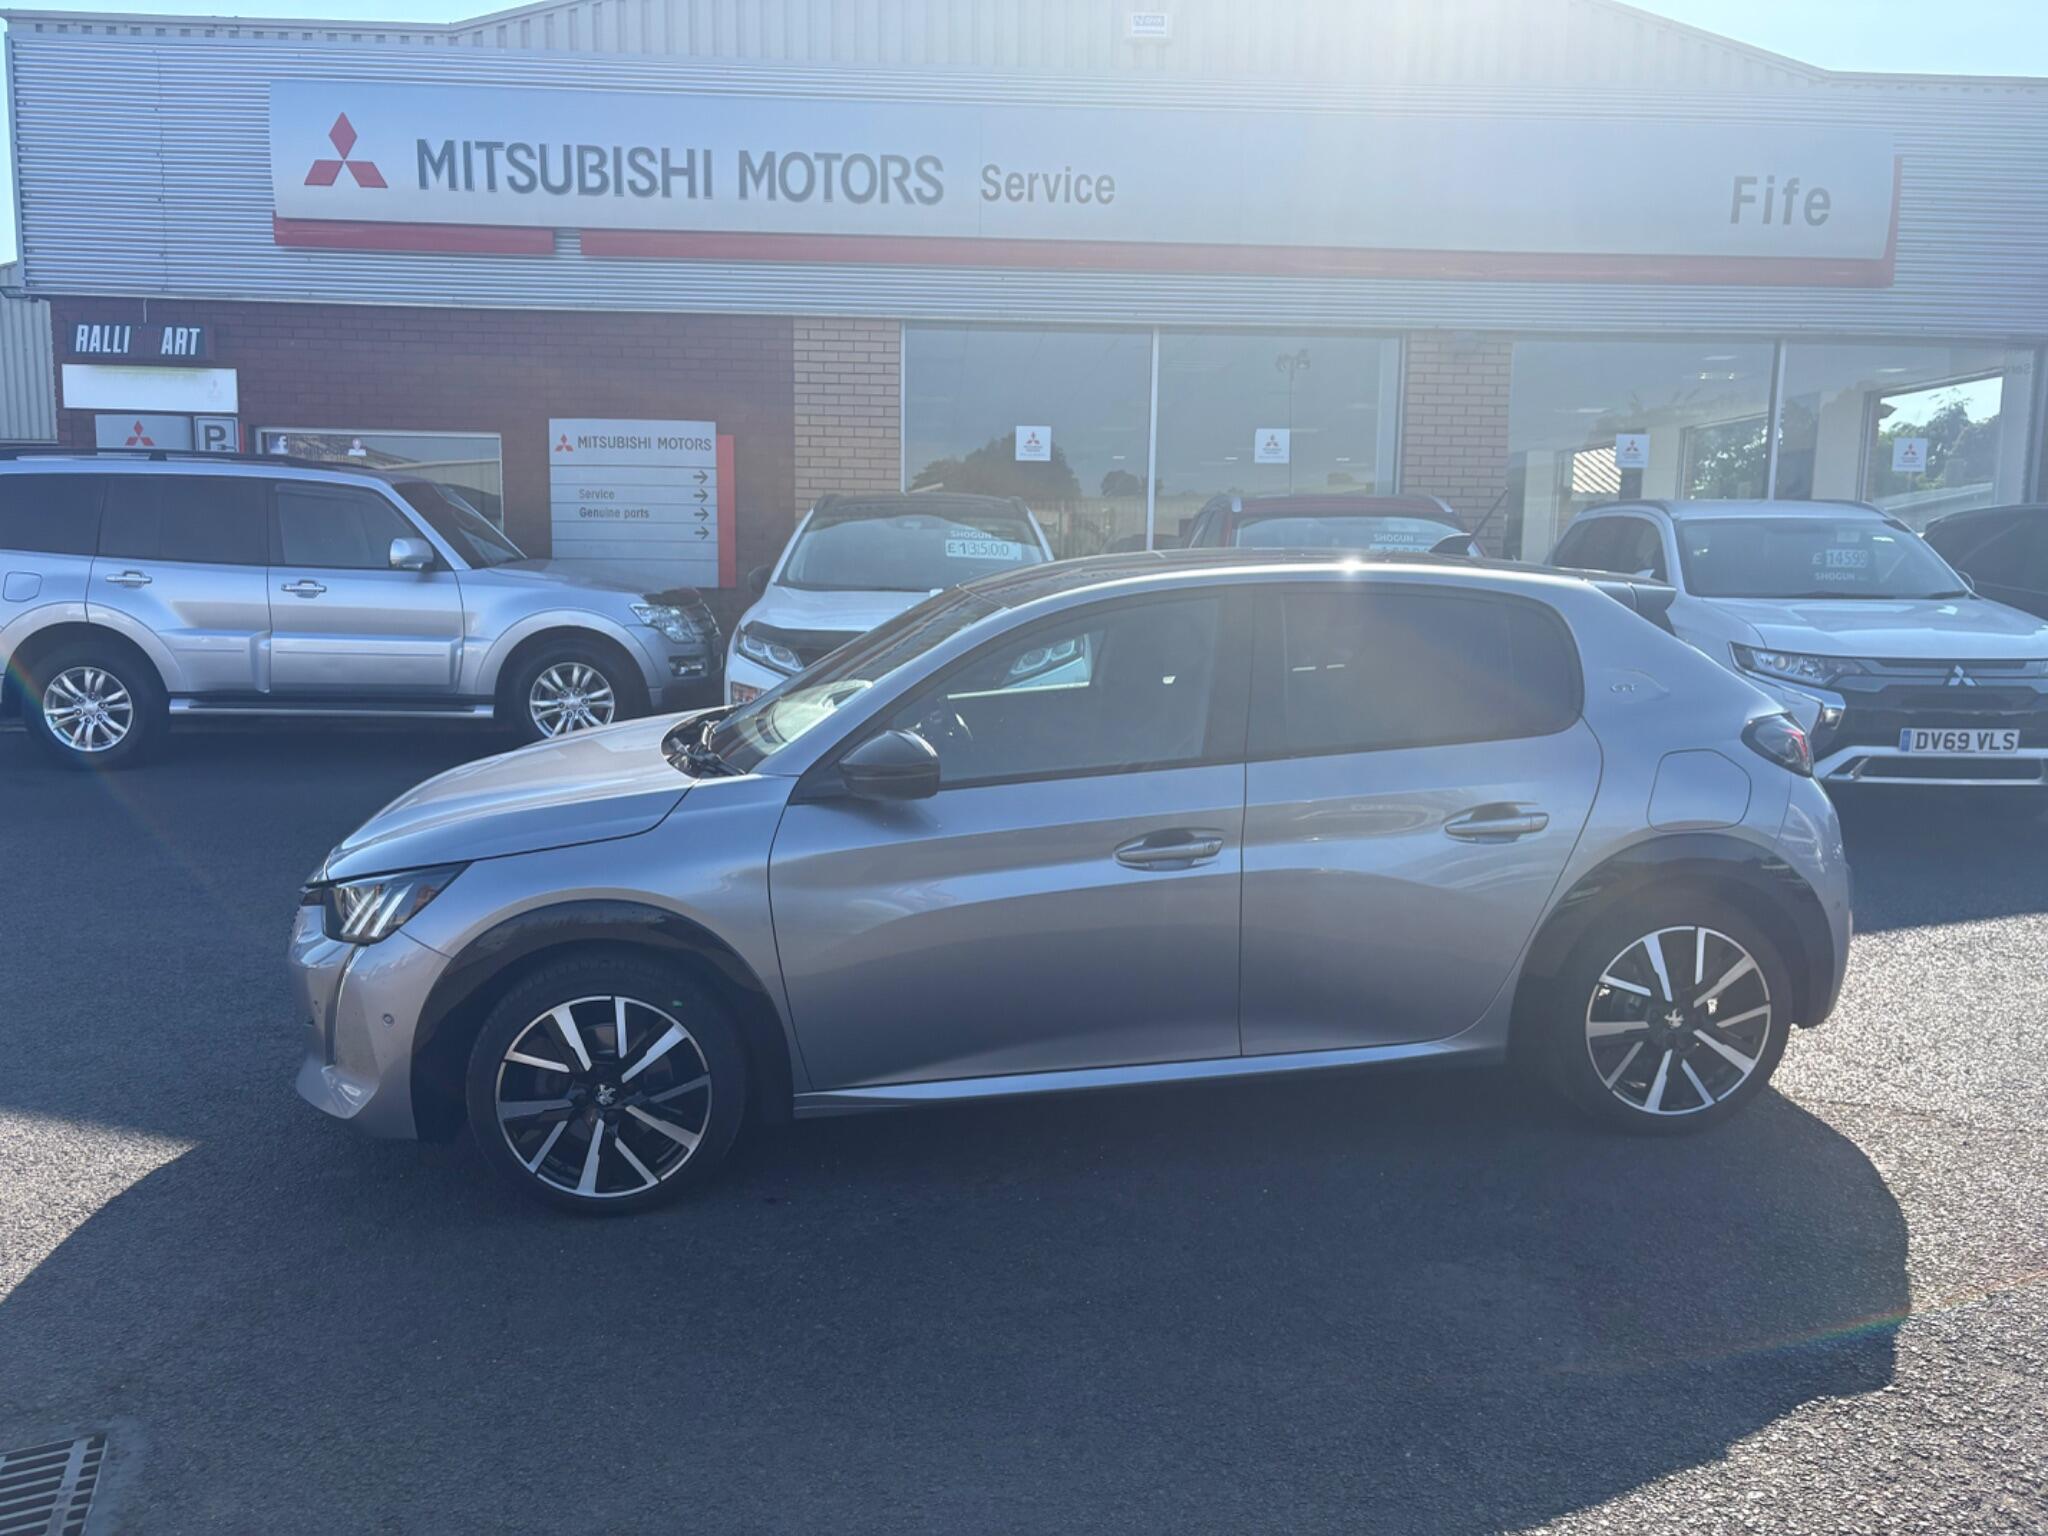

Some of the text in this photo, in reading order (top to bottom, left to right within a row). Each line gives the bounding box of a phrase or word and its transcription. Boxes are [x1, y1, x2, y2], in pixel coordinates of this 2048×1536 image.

[416, 138, 1116, 205] MITSUBISHI MOTORS Service
[1729, 175, 1832, 226] Fife
[75, 324, 201, 356] RALLI ART
[577, 435, 713, 451] MITSUBISHI MOTORS
[578, 488, 616, 501] Service
[578, 506, 650, 521] Genuine parts
[1914, 731, 2016, 752] DV69 VLS
